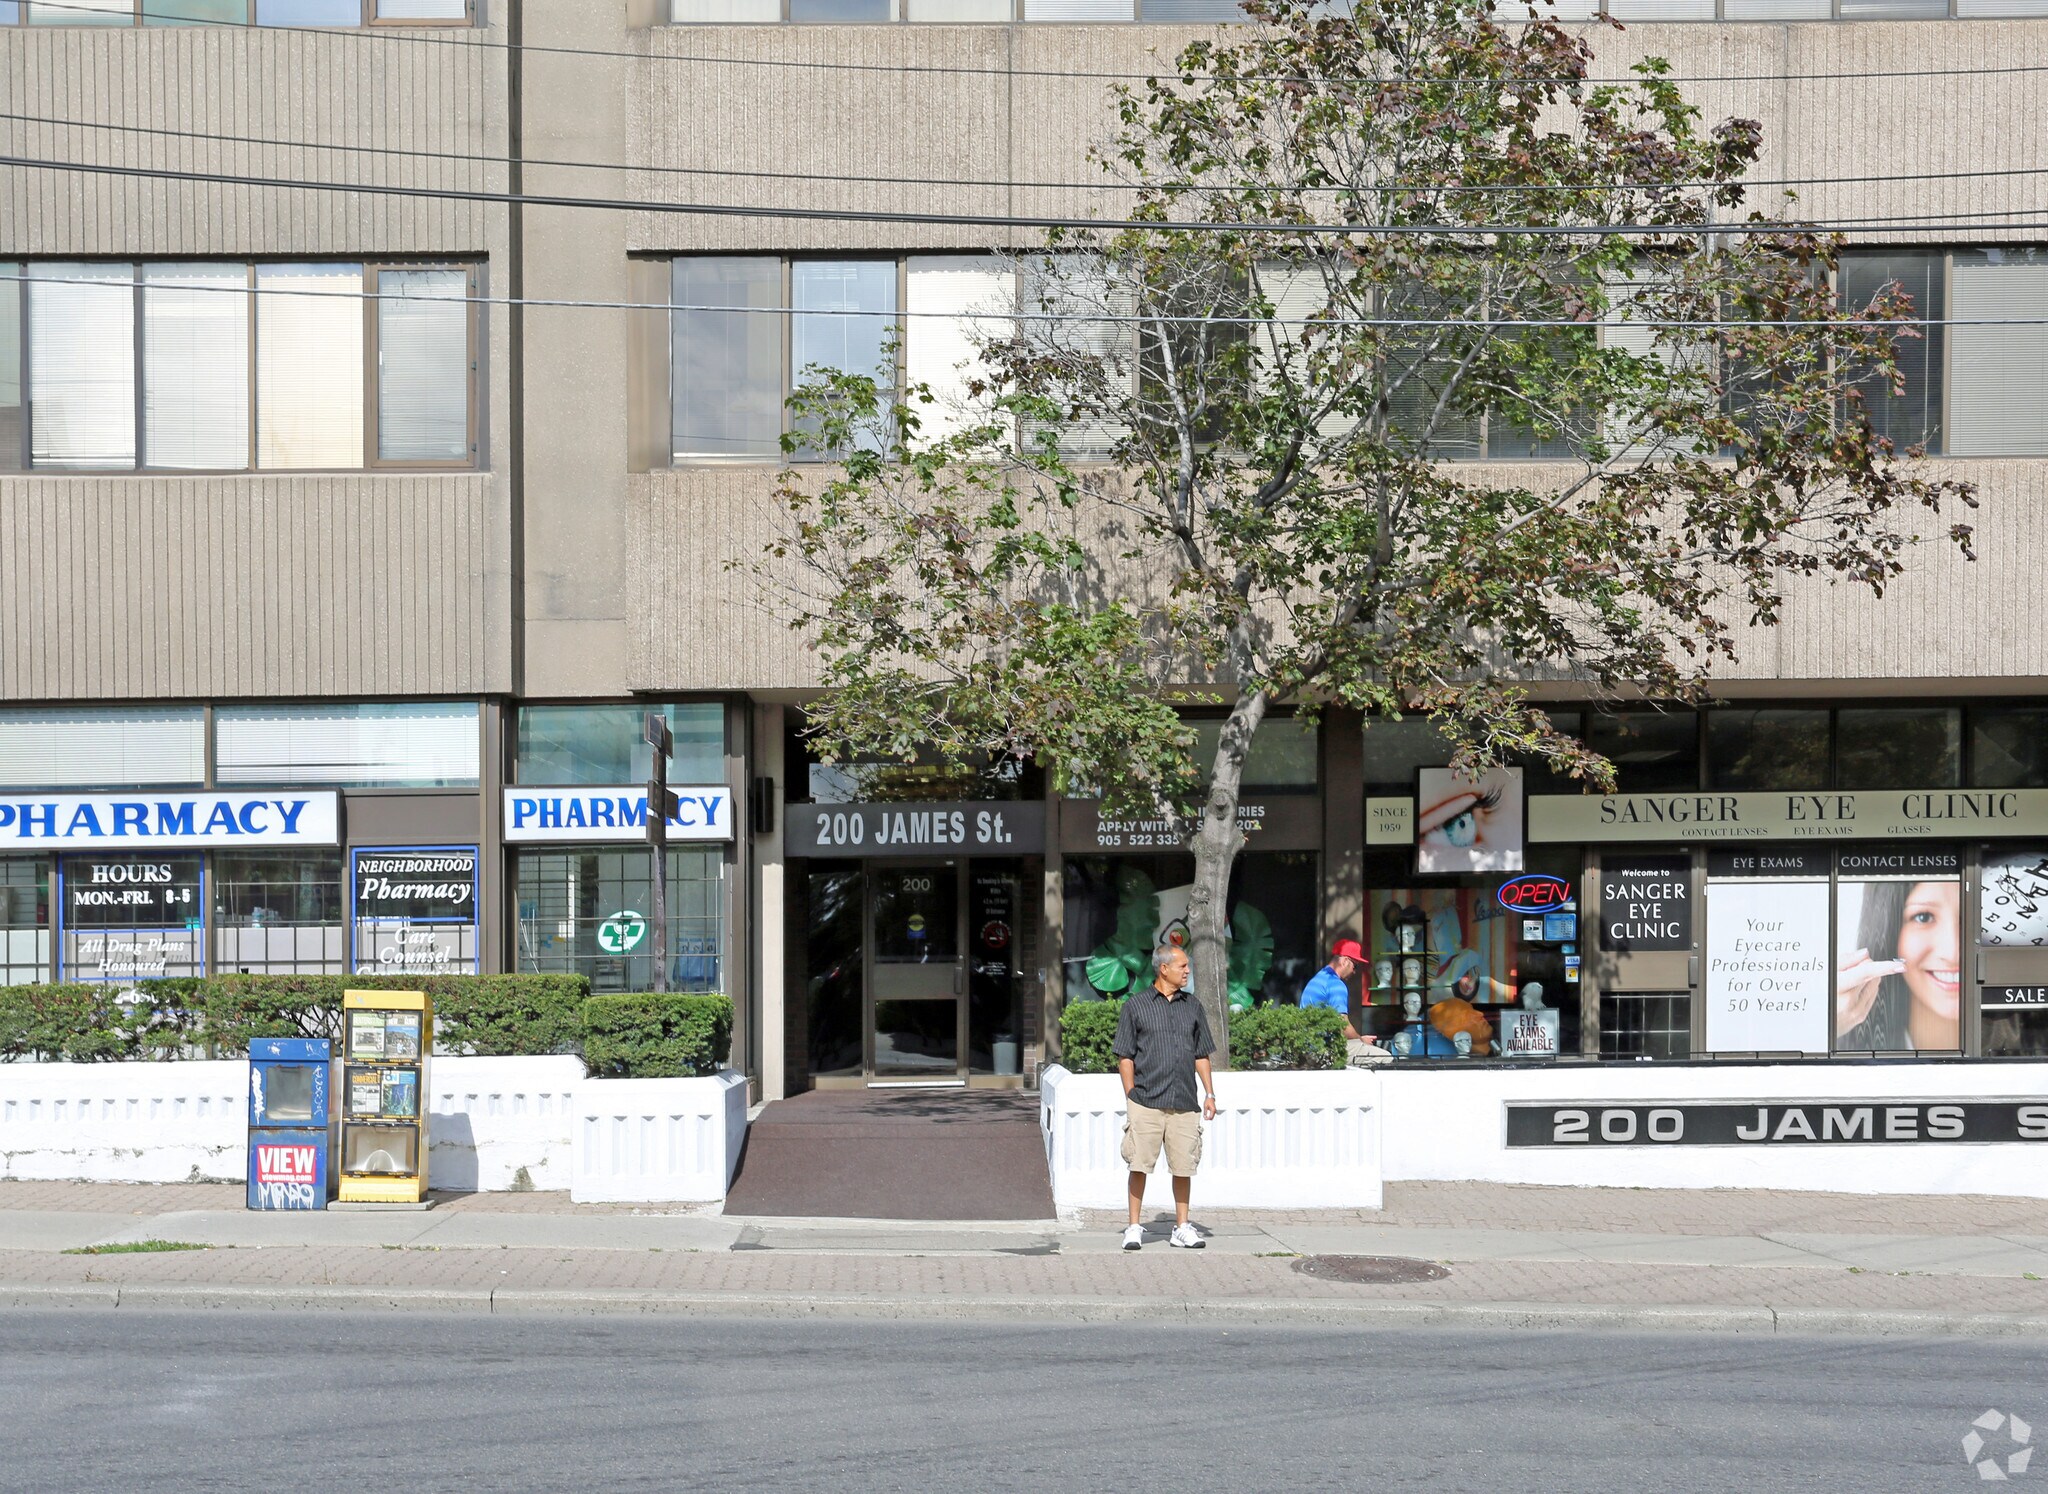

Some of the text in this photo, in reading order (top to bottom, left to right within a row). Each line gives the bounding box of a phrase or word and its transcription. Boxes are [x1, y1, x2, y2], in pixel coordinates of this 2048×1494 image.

[511, 796, 724, 828] PHARMCY
[1373, 807, 1407, 817] SINCE
[1600, 792, 2018, 824] SANGER EYE CLINIC
[0, 800, 310, 838] PHARMACY
[1097, 820, 1136, 832] APPLY
[816, 810, 1012, 845] 200 JAMES St.
[1379, 823, 1401, 832] 1959
[1681, 825, 1932, 837] CONTACT LENSES EYE EXAMS GLASSES
[1097, 834, 1180, 846] 905 522 335
[357, 858, 473, 873] NEIGHBORHOOD
[1733, 857, 1803, 868] EYE EXAMS
[1840, 855, 1957, 867] CONTACT LENSES
[91, 864, 173, 883] HOURS
[1621, 869, 1670, 877] Welcome to
[360, 877, 471, 904] Pharmacy
[902, 878, 931, 891] 200
[1605, 883, 1686, 900] SANGER
[74, 890, 154, 905] MON.-FRI.
[1500, 882, 1570, 904] OPEN
[1629, 903, 1662, 919] EYE
[1610, 922, 1680, 939] CLINIC
[1746, 918, 1784, 932] Your
[394, 927, 436, 945] Care
[79, 938, 185, 955] All Drug Plans
[1735, 938, 1801, 956] Eyecare
[380, 946, 451, 964] Counsel
[97, 958, 167, 972] Honoured
[1711, 957, 1825, 972] Professionals
[1727, 977, 1802, 992] for Over
[2005, 988, 2046, 1003] SALE
[1727, 997, 1807, 1012] 50 Years!
[1519, 1014, 1538, 1026] EYE
[1513, 1026, 1546, 1039] EXAMS
[1506, 1038, 1554, 1051] AVAILABLE
[1553, 1106, 2048, 1142] 200 JAMES S
[258, 1147, 315, 1173] VIEW
